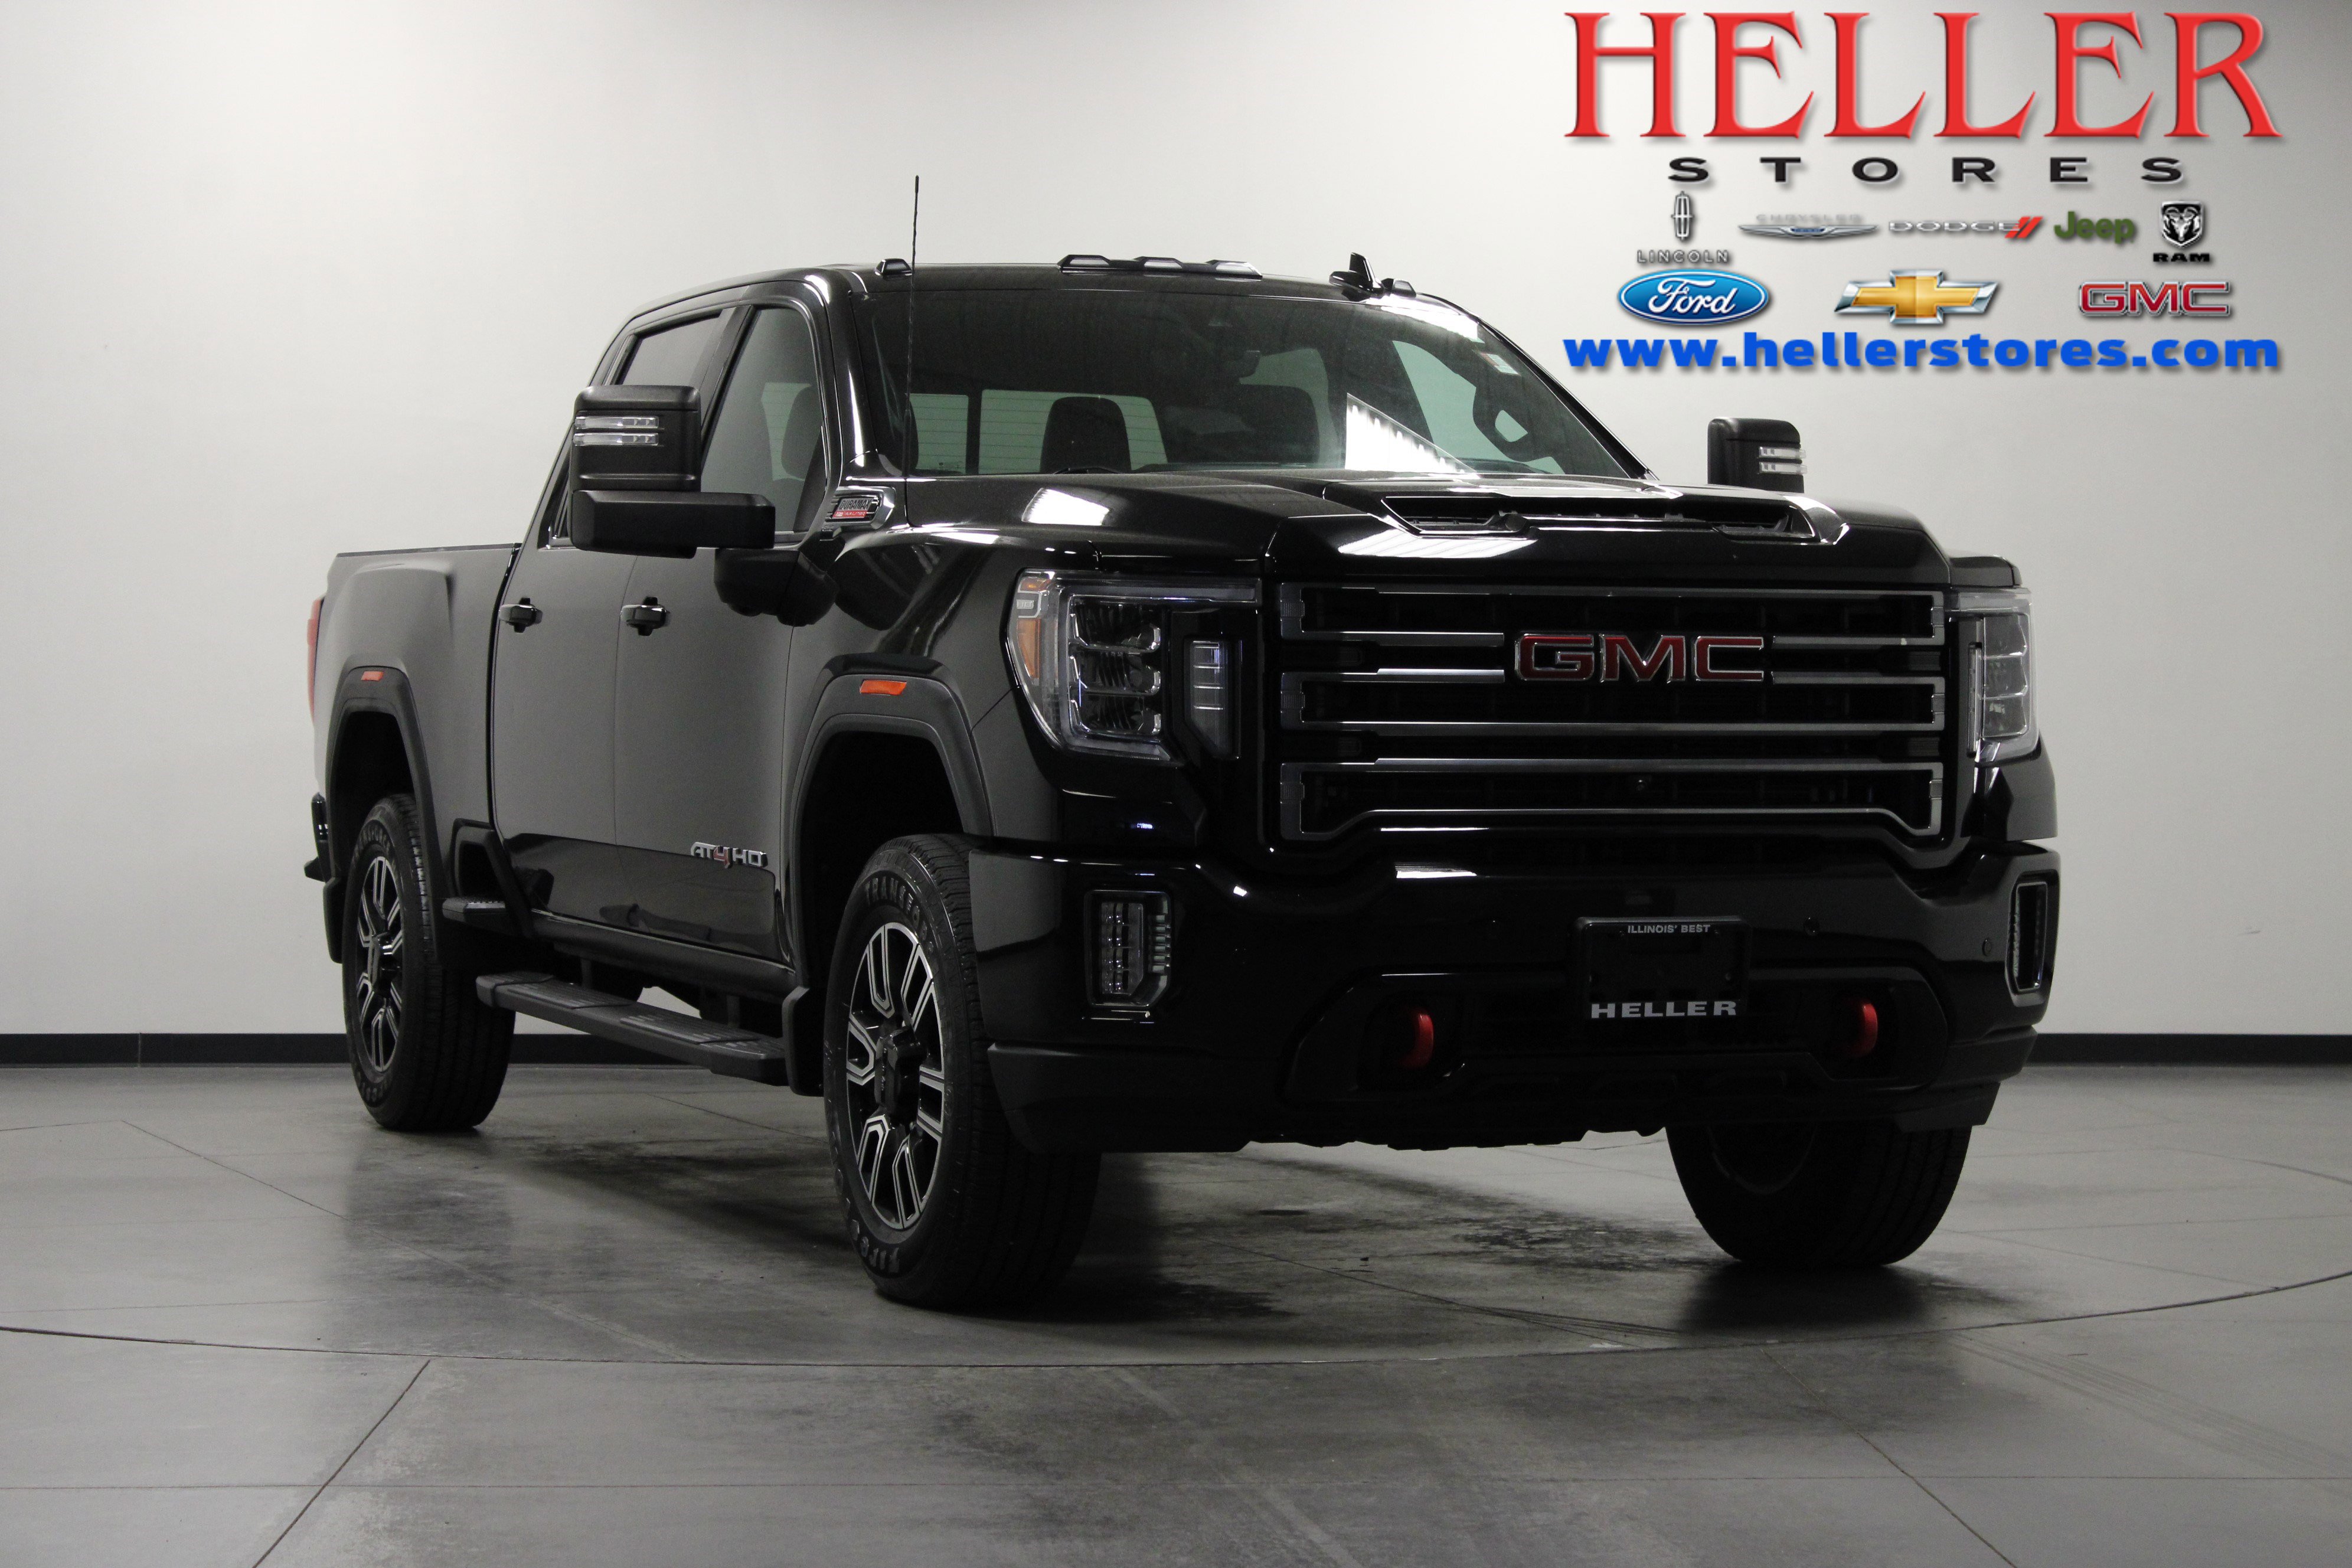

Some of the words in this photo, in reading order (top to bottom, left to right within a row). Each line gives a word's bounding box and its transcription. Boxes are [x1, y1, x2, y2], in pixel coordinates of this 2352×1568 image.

[1515, 633, 1764, 684] GMC
[1627, 925, 1678, 934] ILLINOIS'
[1680, 924, 1711, 933] BEST
[1591, 1001, 1737, 1019] HELLER
